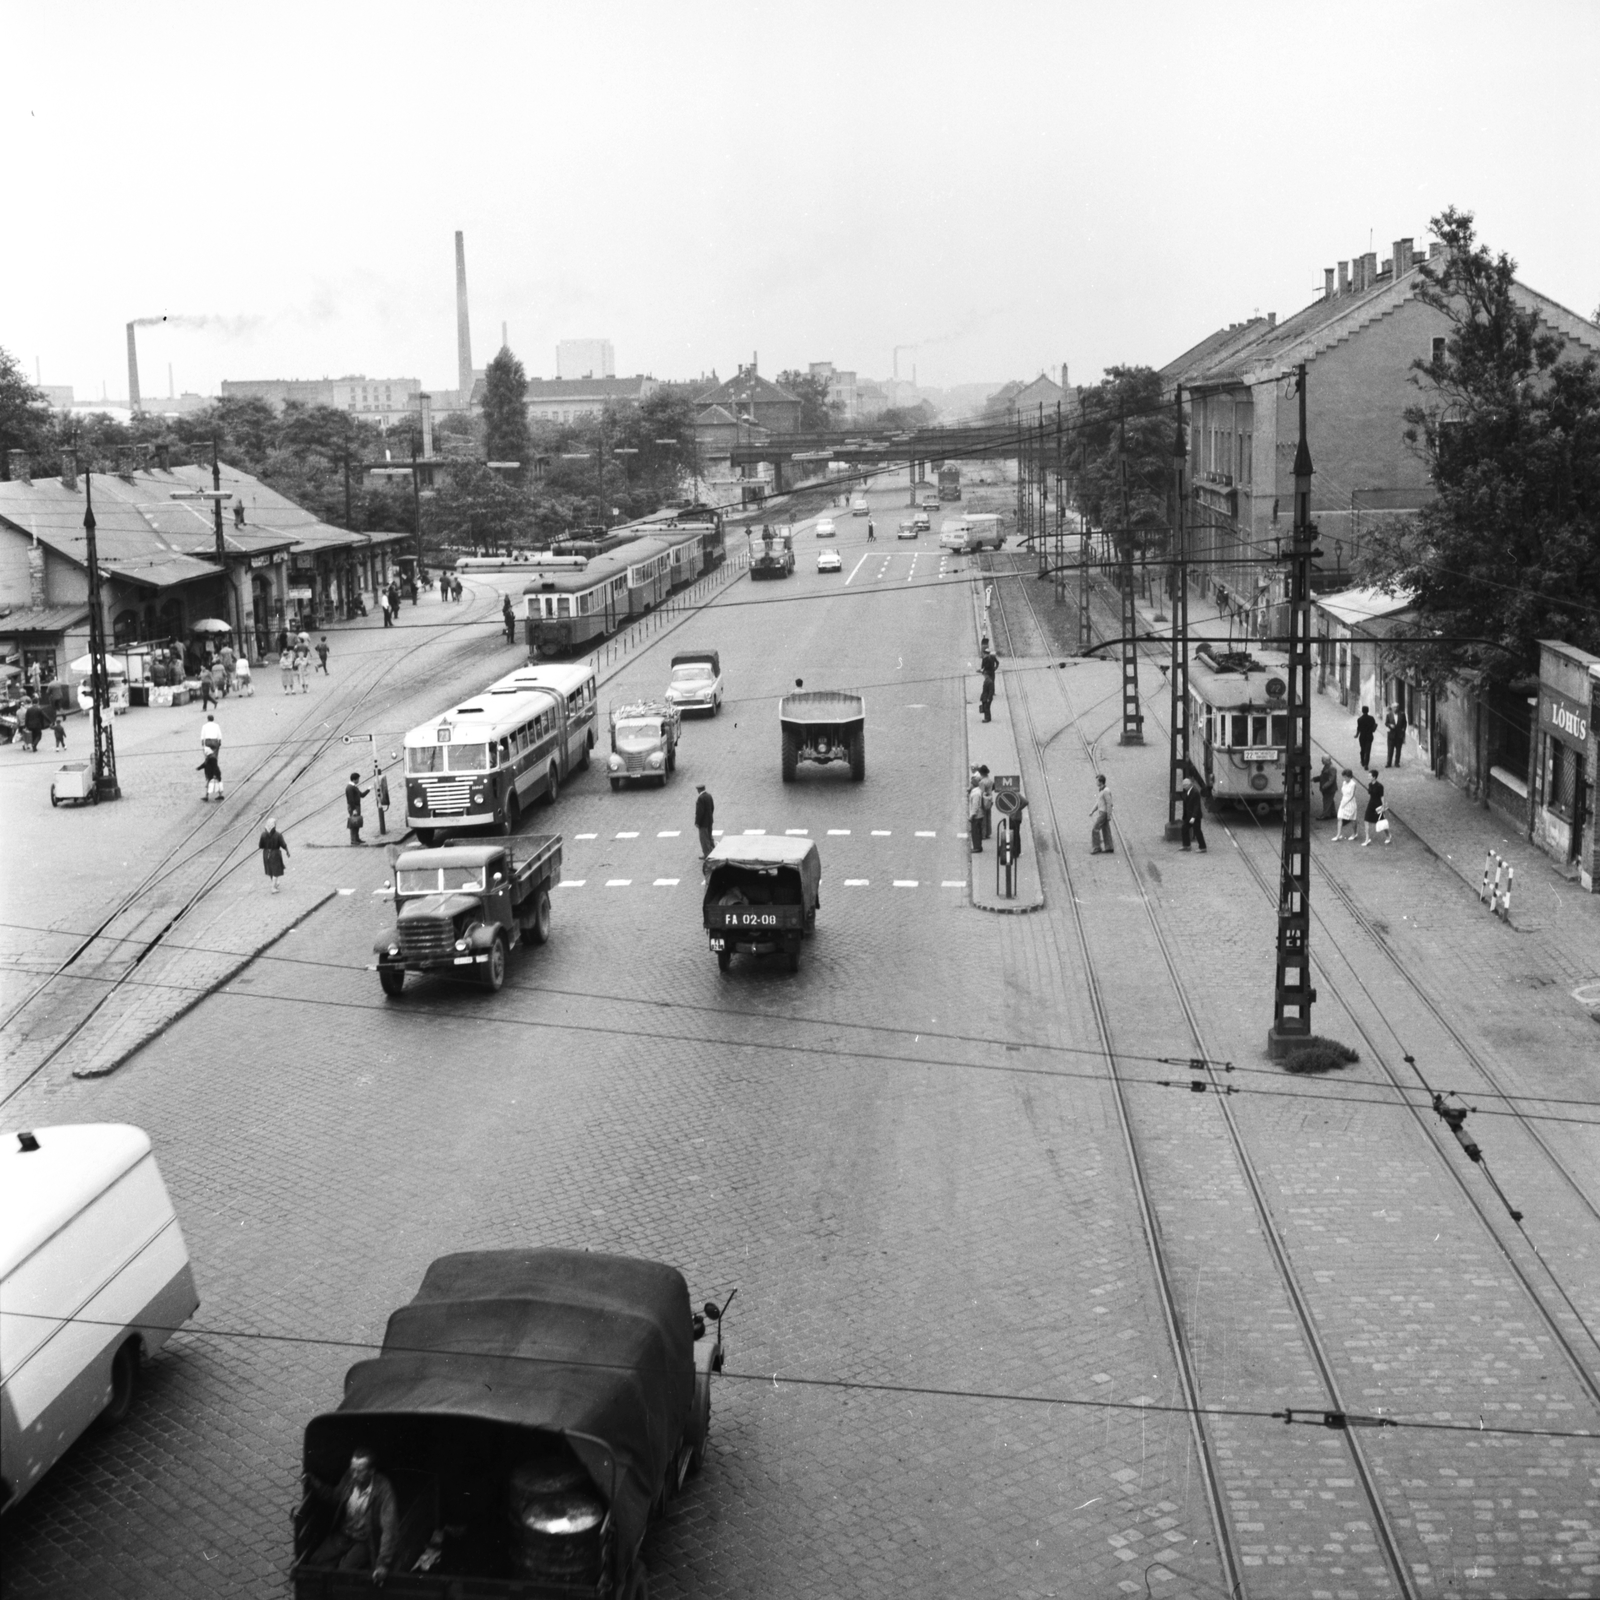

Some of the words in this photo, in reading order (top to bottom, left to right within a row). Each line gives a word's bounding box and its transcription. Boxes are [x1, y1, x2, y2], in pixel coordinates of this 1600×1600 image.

[1551, 701, 1587, 740] LÓHÚS
[1245, 751, 1254, 759] 22
[1002, 777, 1013, 787] M
[725, 914, 738, 925] FA
[742, 914, 776, 925] 02-08
